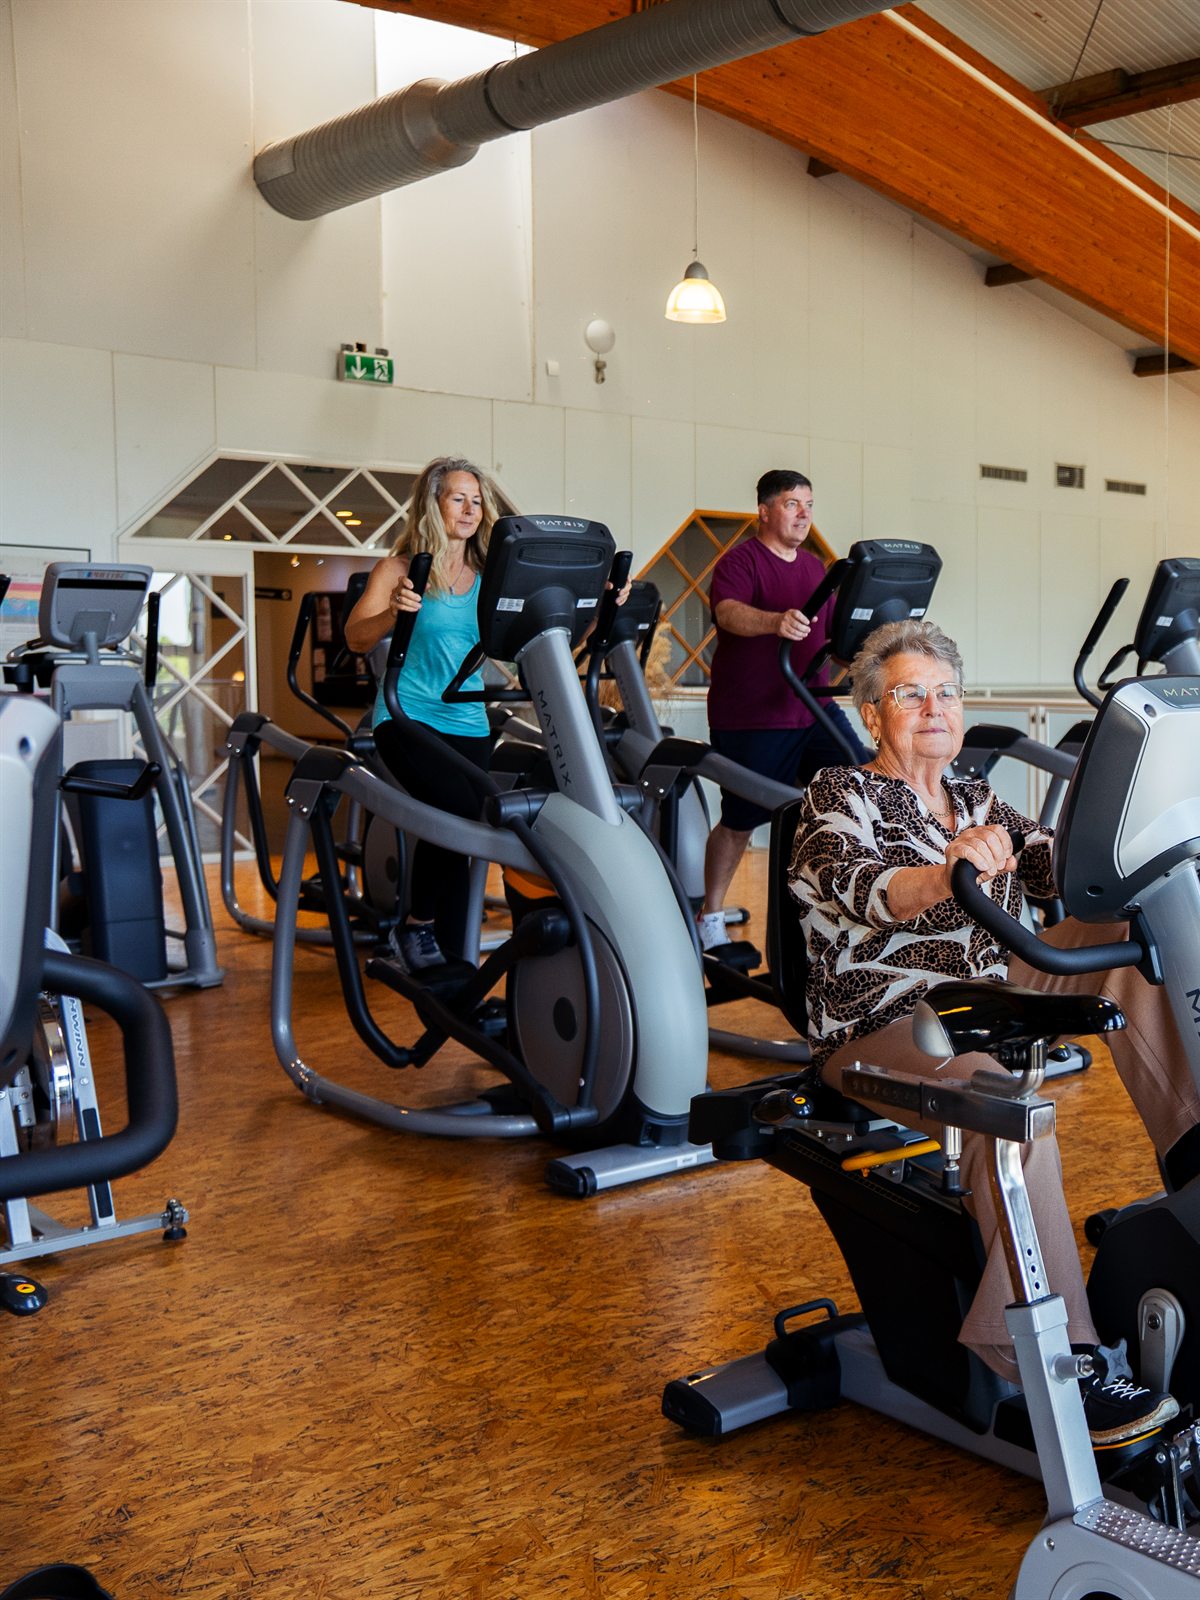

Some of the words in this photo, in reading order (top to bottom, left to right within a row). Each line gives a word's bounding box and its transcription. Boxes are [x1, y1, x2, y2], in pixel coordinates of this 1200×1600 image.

[535, 520, 585, 528] MATRIX
[538, 690, 572, 787] MATRIX
[68, 997, 87, 1067] HWINN
